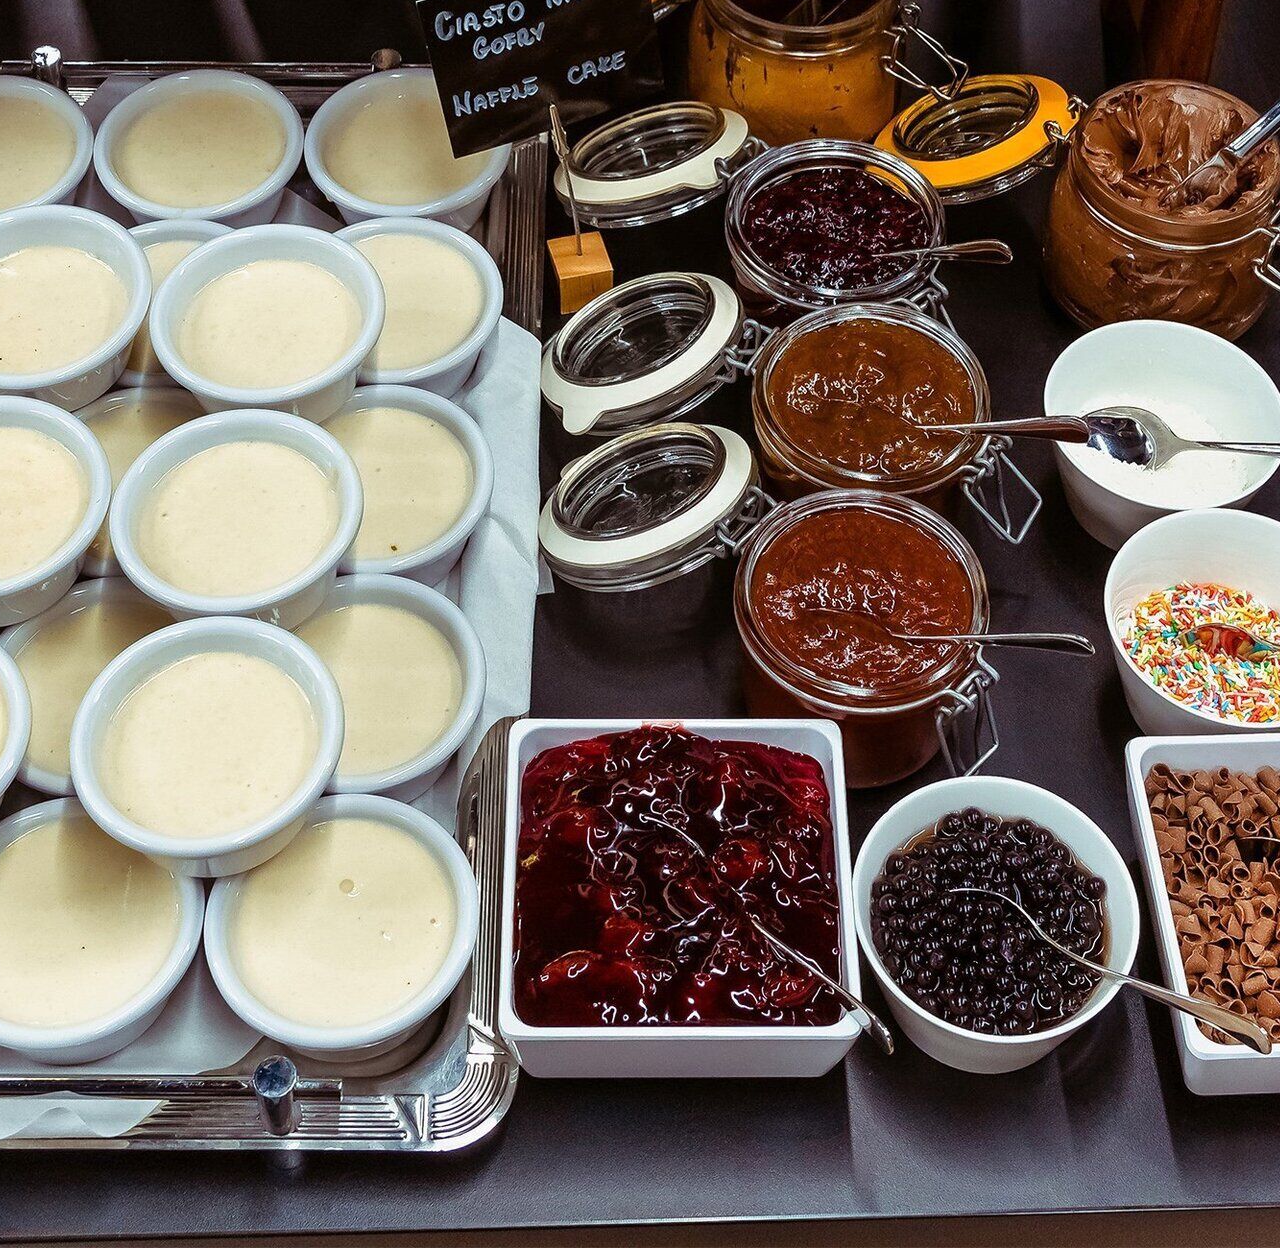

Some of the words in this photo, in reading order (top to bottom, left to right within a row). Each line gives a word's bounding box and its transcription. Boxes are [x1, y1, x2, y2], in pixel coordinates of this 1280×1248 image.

[435, 0, 525, 41] CIASTO
[473, 21, 545, 60] GOFRY
[567, 51, 626, 85] CAKE
